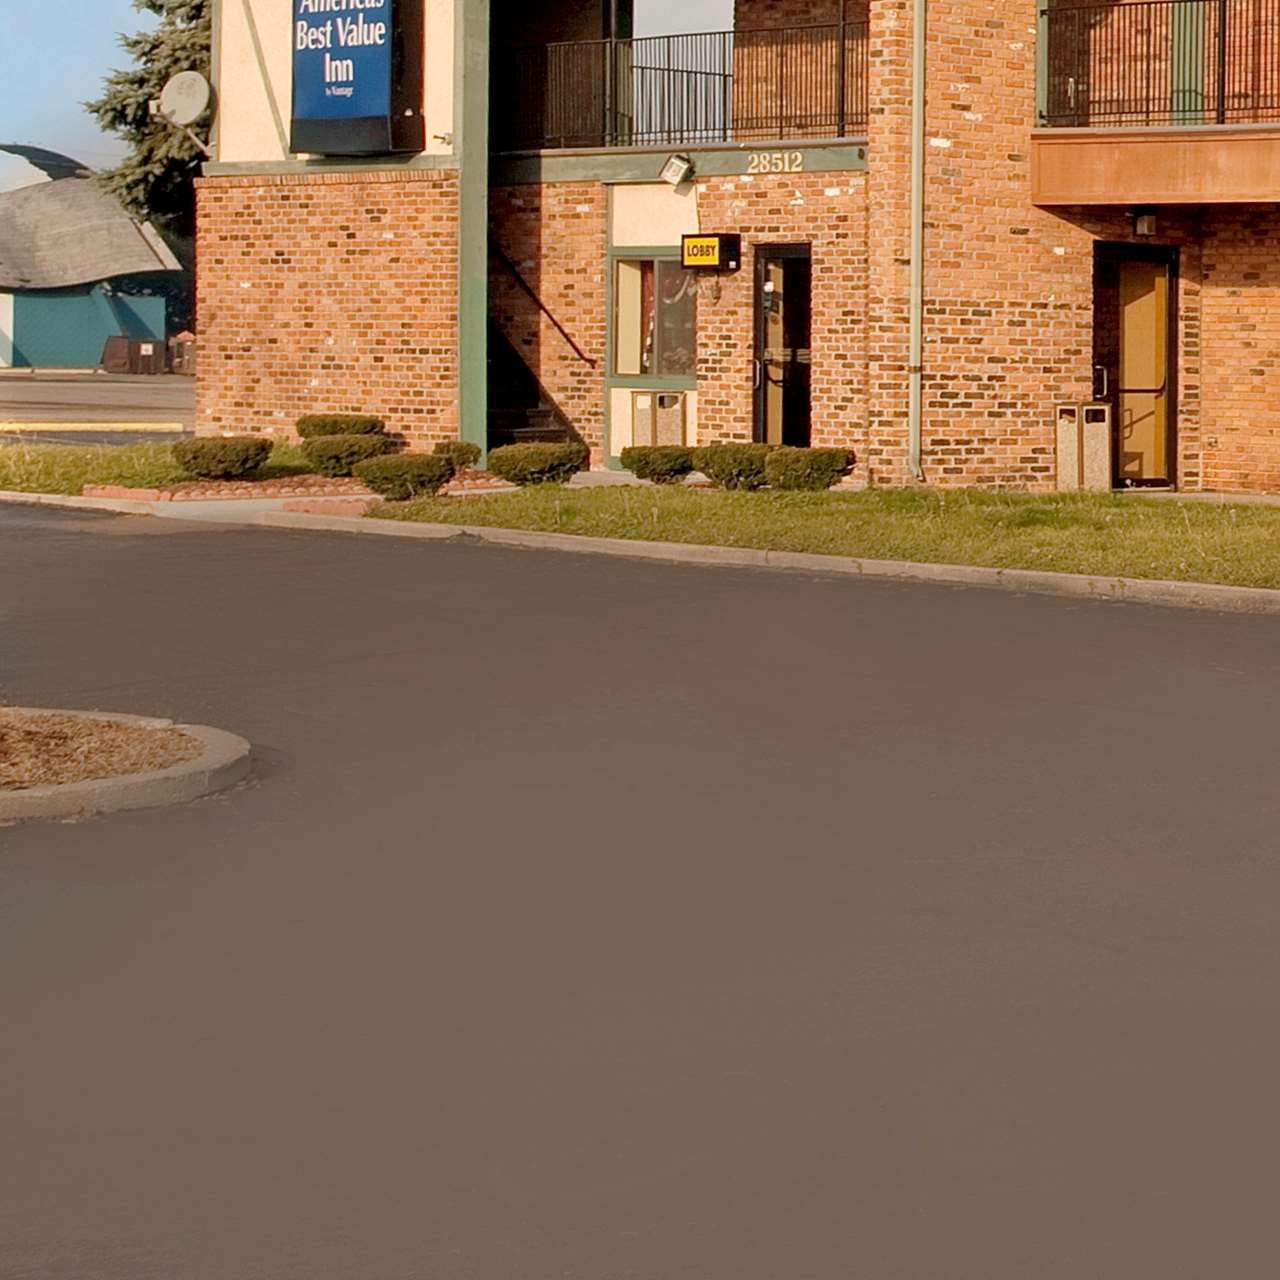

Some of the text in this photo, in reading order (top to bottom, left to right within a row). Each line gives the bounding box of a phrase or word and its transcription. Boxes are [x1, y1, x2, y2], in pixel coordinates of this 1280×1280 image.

[296, 13, 386, 50] Best Value
[324, 53, 354, 83] Inn
[747, 152, 803, 174] 28512
[687, 245, 716, 257] LOBBY
